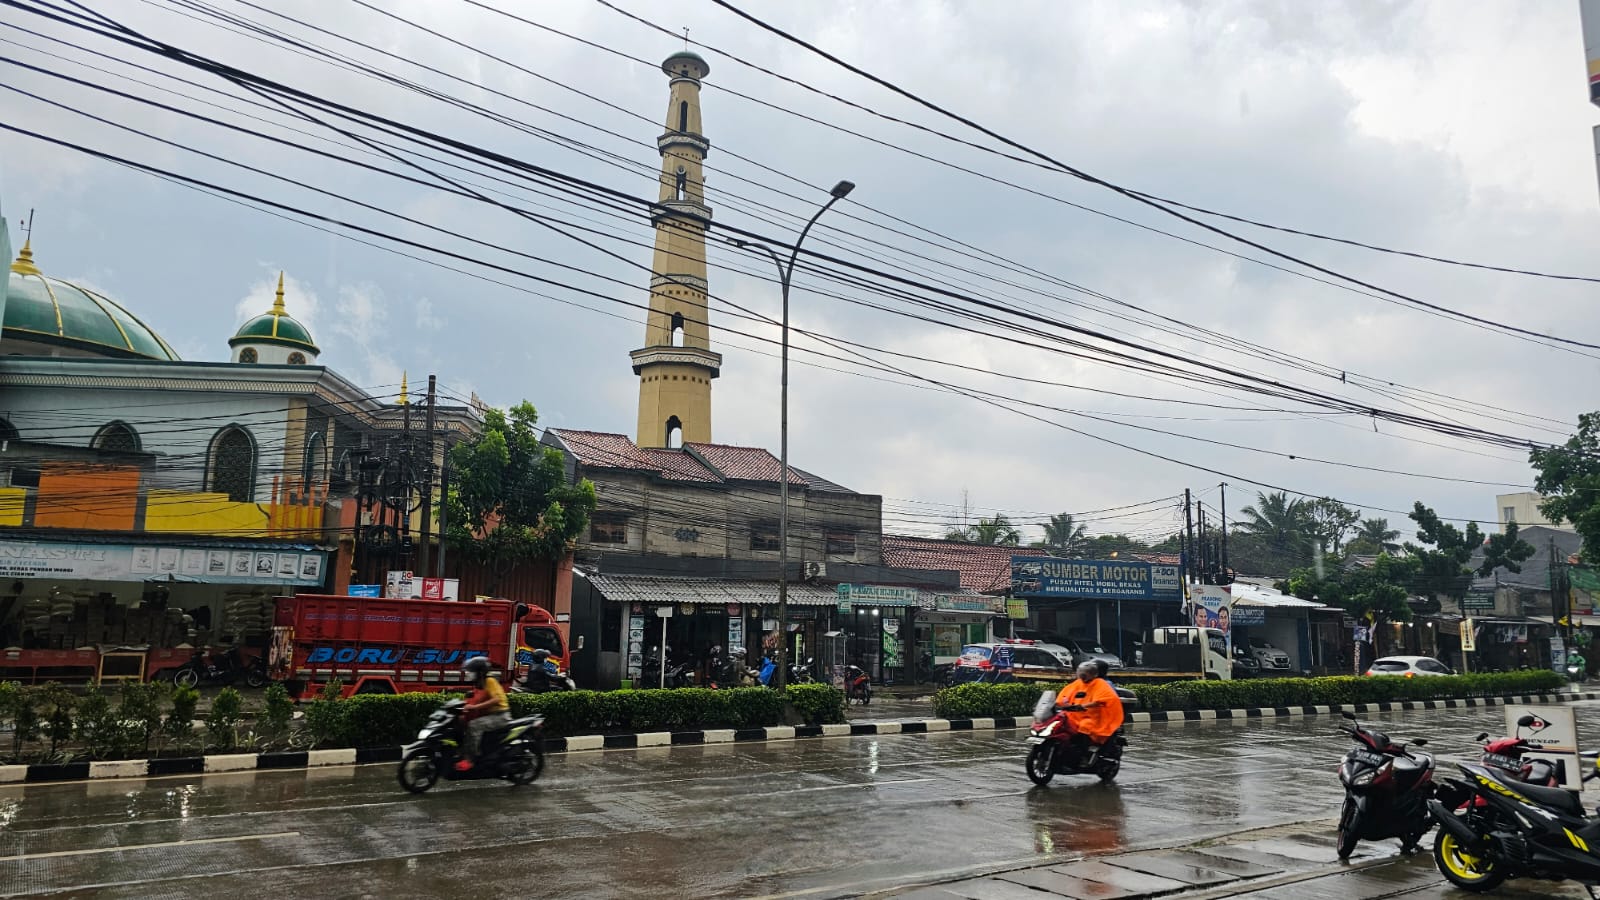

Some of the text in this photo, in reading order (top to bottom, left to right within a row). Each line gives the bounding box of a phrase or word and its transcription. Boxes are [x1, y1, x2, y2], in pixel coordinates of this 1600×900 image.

[1042, 562, 1148, 582] SUMBER MOTOR
[1160, 567, 1175, 577] BCA
[1152, 577, 1179, 586] finance
[1046, 586, 1094, 594] BERKUALITAS
[306, 647, 403, 665] BORU
